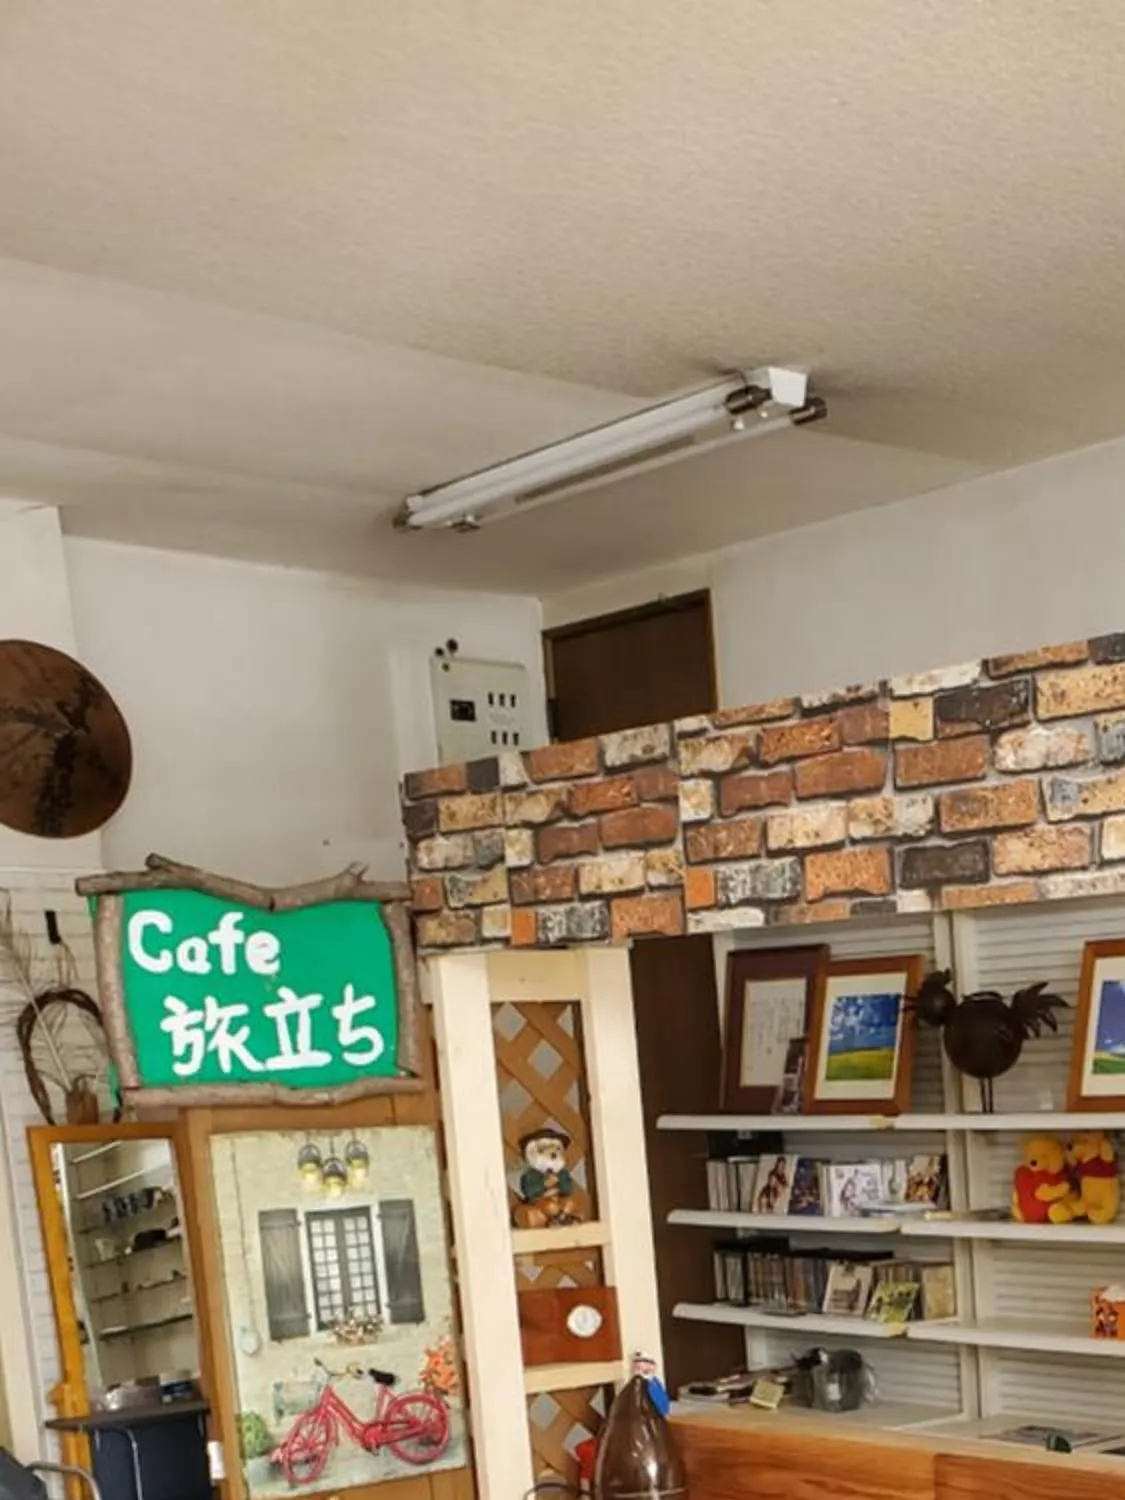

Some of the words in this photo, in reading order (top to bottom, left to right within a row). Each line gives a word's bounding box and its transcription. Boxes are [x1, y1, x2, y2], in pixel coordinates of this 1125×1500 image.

[127, 910, 281, 976] Cafe
[159, 983, 385, 1077] 旅立ち
